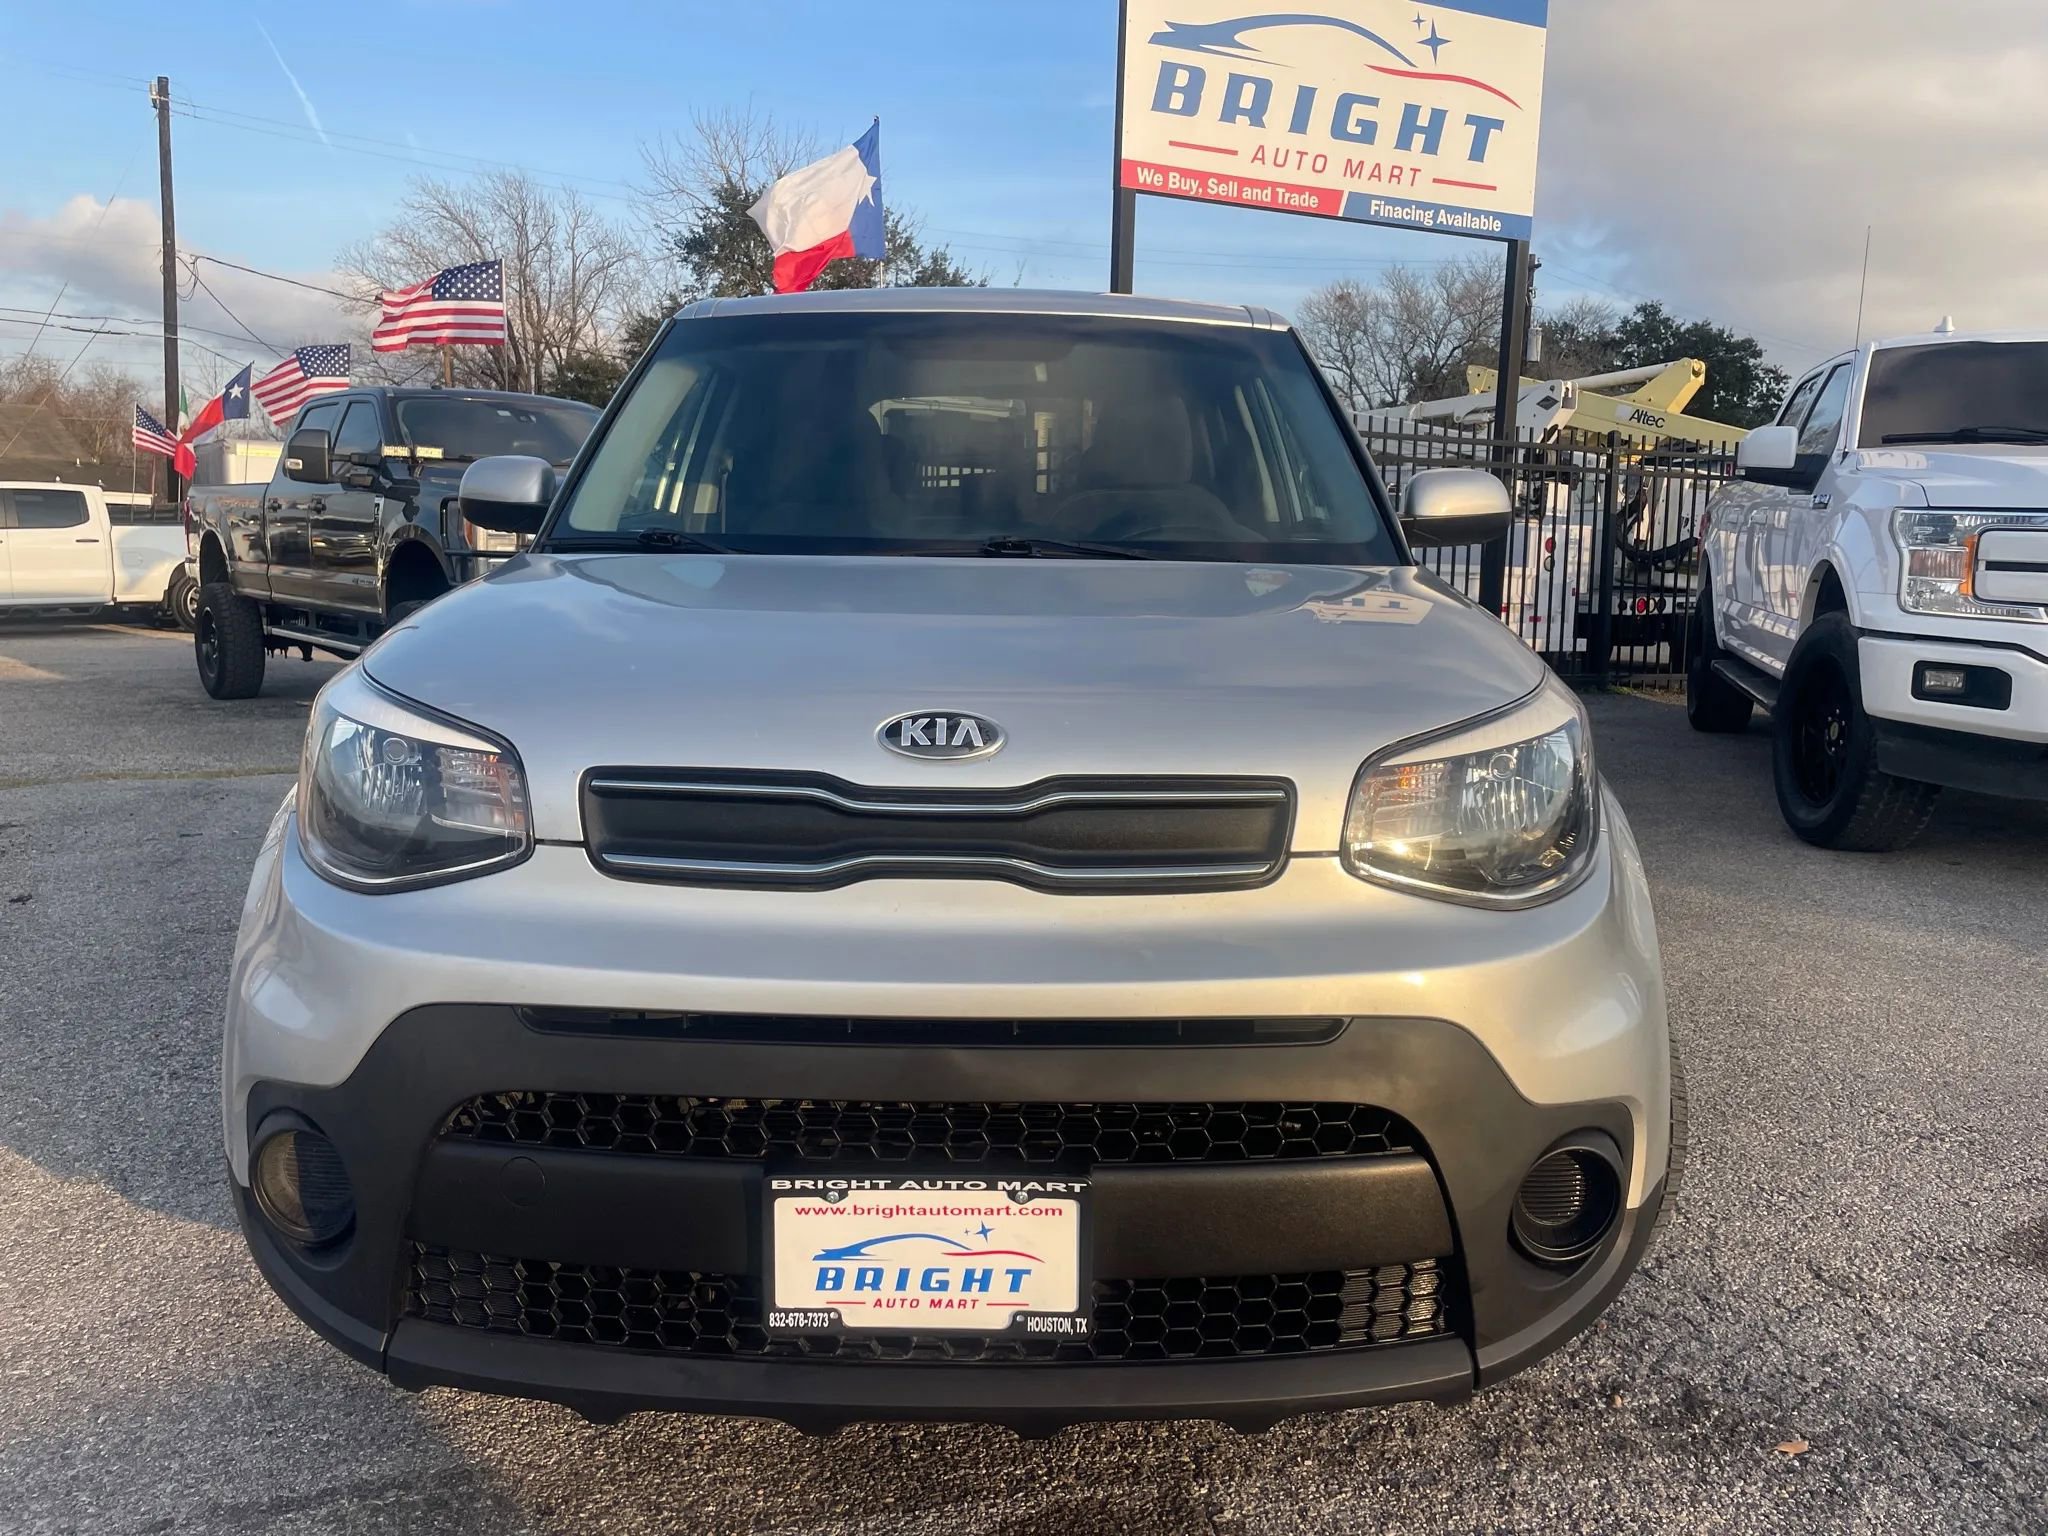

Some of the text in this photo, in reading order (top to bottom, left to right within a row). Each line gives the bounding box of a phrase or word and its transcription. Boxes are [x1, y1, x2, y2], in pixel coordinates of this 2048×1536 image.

[1150, 60, 1505, 163] BRIGHT
[1251, 144, 1422, 187] AUTO MART
[1136, 166, 1319, 208] We Buy, Sell and Trade
[1370, 199, 1502, 232] Finacing Available
[1629, 409, 1665, 428] Altec
[901, 718, 984, 746] KIA
[771, 1179, 1088, 1193] BRIGHT AUTO MART
[794, 1204, 1063, 1219] www.brightautomart.com
[815, 1267, 1032, 1293] BRIGHT
[873, 1298, 980, 1310] AUTO MART
[768, 1312, 829, 1328] 832-678-7373
[1027, 1317, 1087, 1334] HOUSTON, TX
